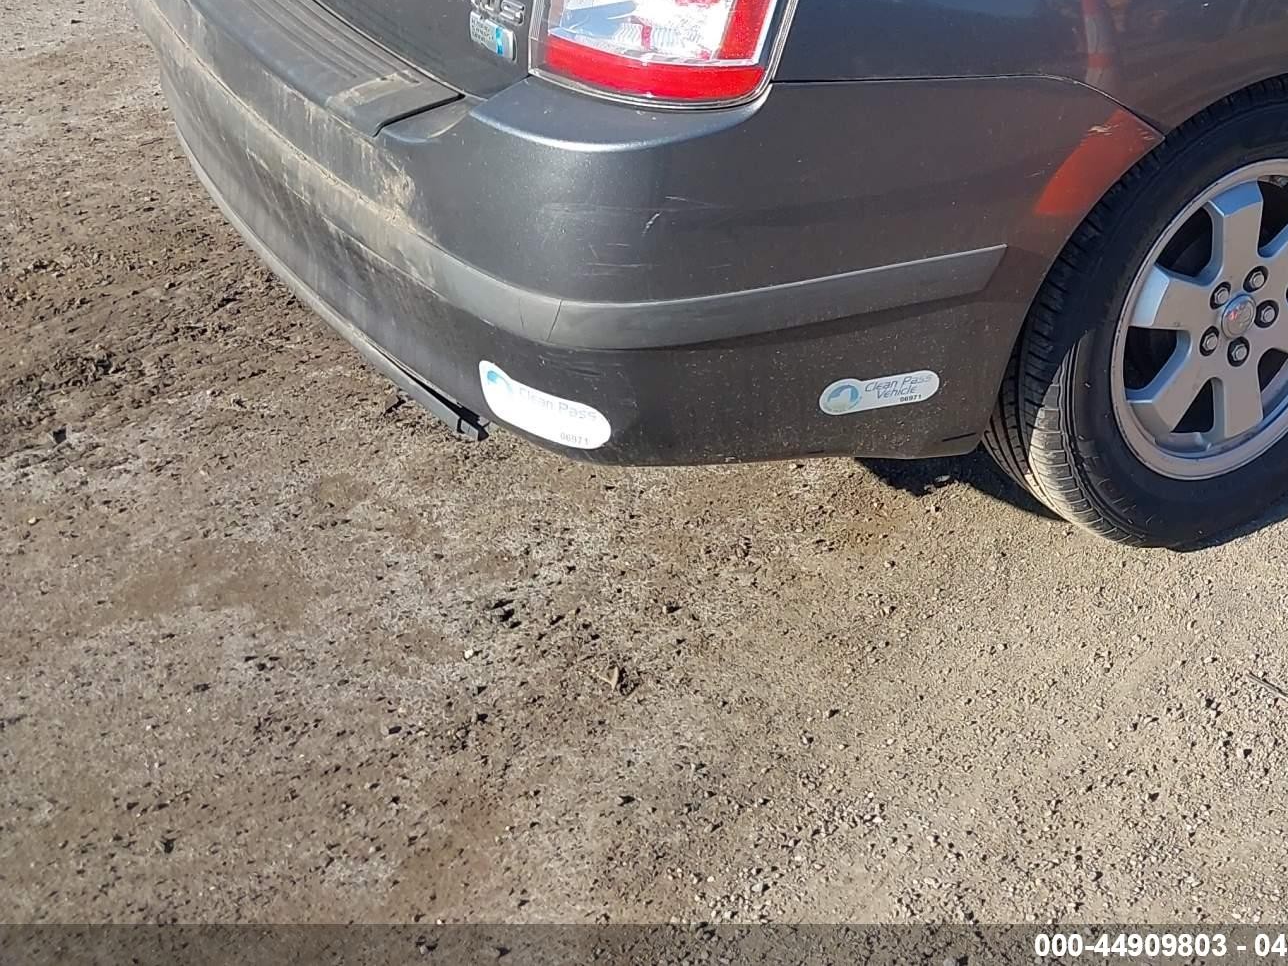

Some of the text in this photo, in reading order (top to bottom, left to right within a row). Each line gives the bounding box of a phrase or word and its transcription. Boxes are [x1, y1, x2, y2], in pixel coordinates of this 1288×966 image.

[865, 375, 932, 392] Clean Pass
[876, 385, 918, 399] Vehicle
[558, 401, 597, 420] Pass
